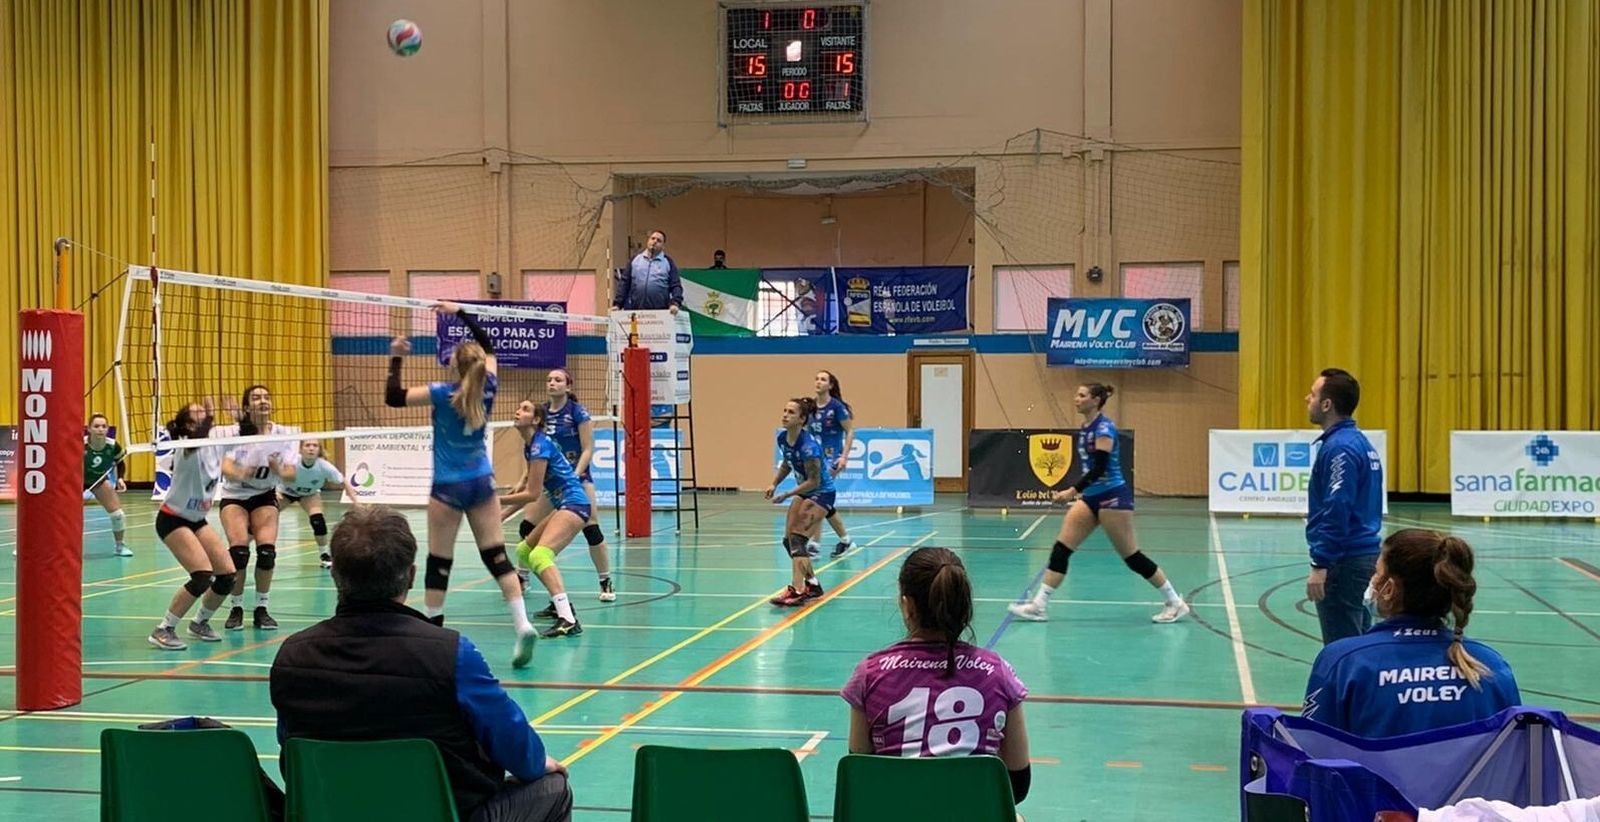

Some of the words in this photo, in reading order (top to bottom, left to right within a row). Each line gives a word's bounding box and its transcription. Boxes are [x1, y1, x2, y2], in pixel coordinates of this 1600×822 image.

[733, 38, 768, 49] LOCAL
[821, 36, 856, 46] VISITANTE
[749, 56, 765, 75] 15
[836, 54, 853, 73] 15
[782, 67, 807, 77] PERIODO
[738, 102, 763, 111] FALTAS
[778, 101, 809, 111] JUGADOR
[825, 101, 850, 110] FALTAS
[893, 282, 937, 296] FEDERACIÓN
[911, 301, 921, 312] DE
[922, 299, 956, 312] VOLEIBOL
[448, 326, 500, 337] ESPIO
[503, 328, 535, 338] PARA
[538, 328, 555, 338] SU
[22, 369, 52, 494] MONDO
[1535, 446, 1551, 455] 24h
[91, 456, 102, 468] 9
[1494, 500, 1595, 513] CIUDADEXPO
[1404, 628, 1438, 636] Zeus
[879, 654, 948, 671] Mairena
[954, 654, 995, 675] Voley
[1398, 685, 1468, 704] VOLEY
[887, 686, 984, 757] 18
